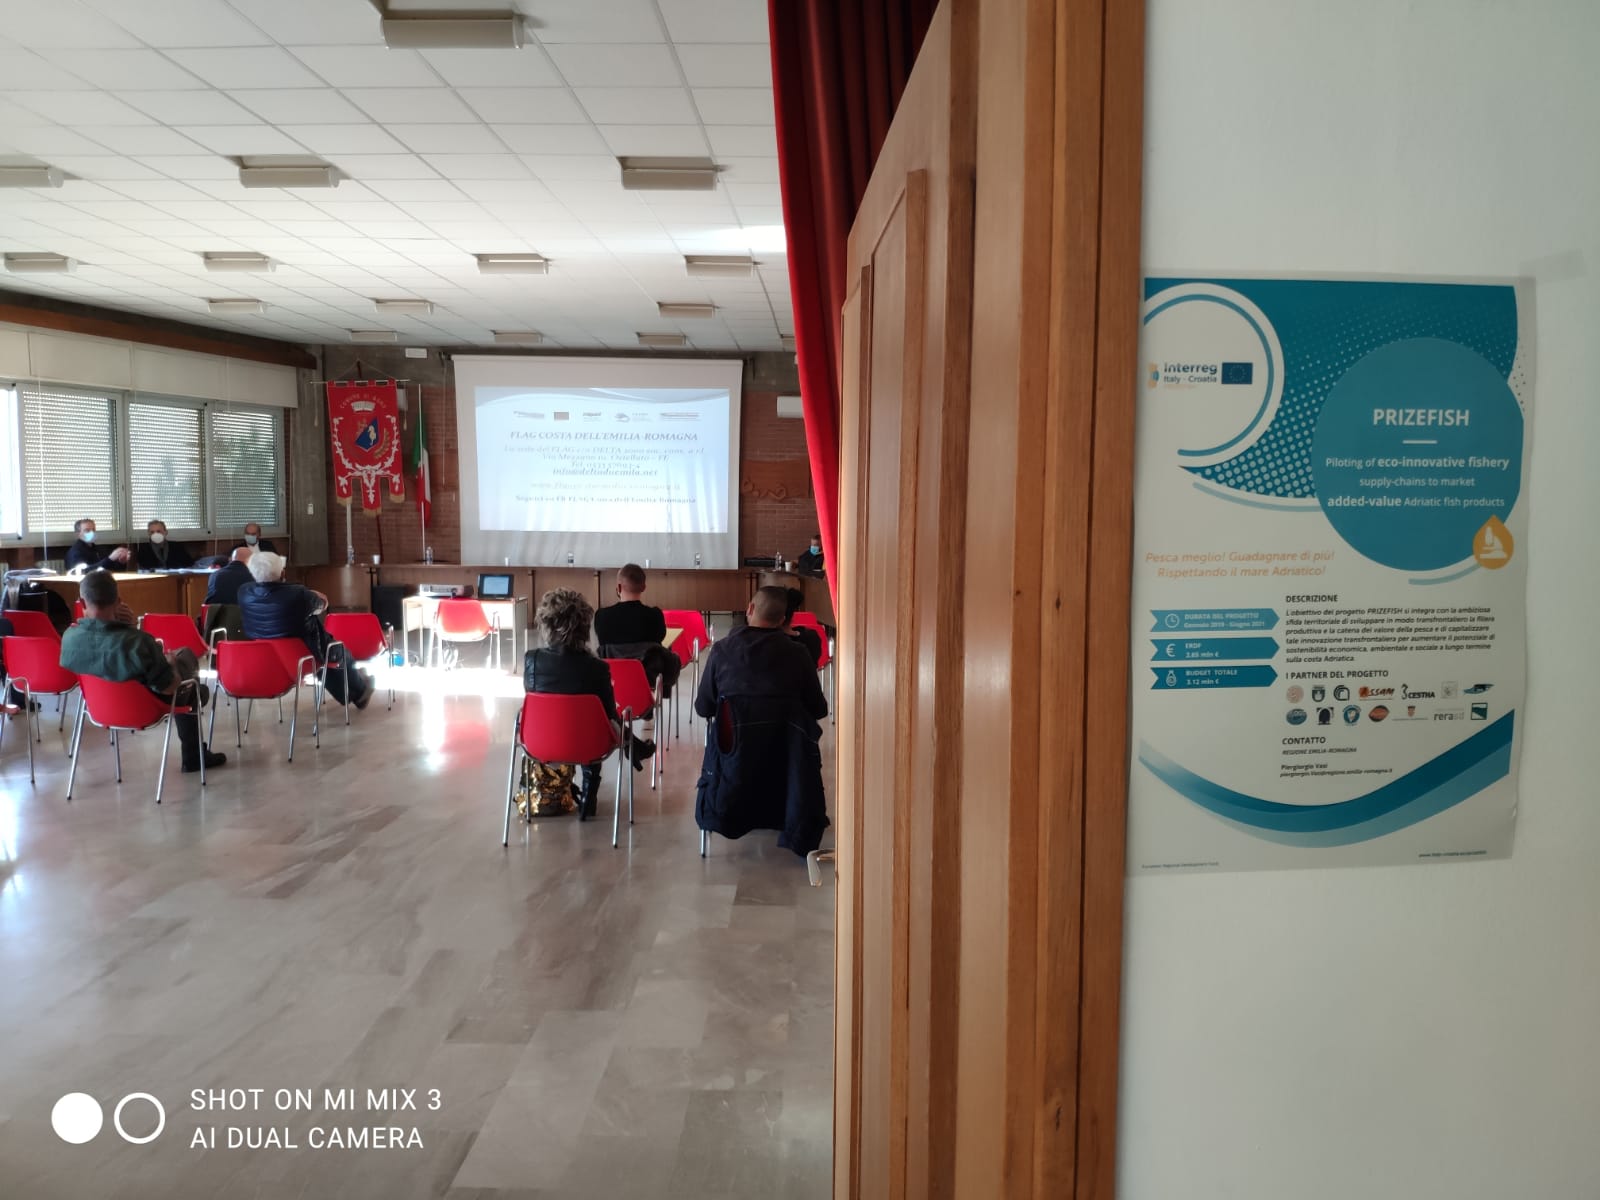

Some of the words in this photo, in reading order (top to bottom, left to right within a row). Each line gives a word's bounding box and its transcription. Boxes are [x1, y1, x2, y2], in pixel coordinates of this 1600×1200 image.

[1373, 408, 1470, 426] PRIZEFISH
[510, 431, 537, 440] FLAG
[538, 432, 572, 440] COSTA
[1325, 458, 1363, 469] Piloting
[1365, 458, 1377, 467] of
[1378, 457, 1465, 468] eco-innovative
[1468, 456, 1509, 471] fishery
[1359, 477, 1426, 489] supply-chains
[1428, 477, 1438, 486] to
[1441, 477, 1475, 486] market
[1327, 495, 1401, 507] added-value
[1403, 497, 1441, 507] Adriatic
[1444, 497, 1461, 506] fish
[1463, 498, 1505, 508] products
[1145, 552, 1178, 562] Pesca
[1182, 552, 1226, 564] meglio!
[1229, 552, 1297, 563] Guadagnare
[1300, 551, 1311, 561] di
[1313, 551, 1335, 562] più!
[1157, 567, 1227, 579] Rispettando
[1230, 567, 1237, 576] il
[1240, 568, 1268, 576] mare
[1272, 566, 1326, 576] Adriatico!
[1286, 595, 1338, 603] DESCRIZIONE
[1347, 670, 1389, 678] PROGETTO
[1282, 736, 1326, 745] CONTATTO
